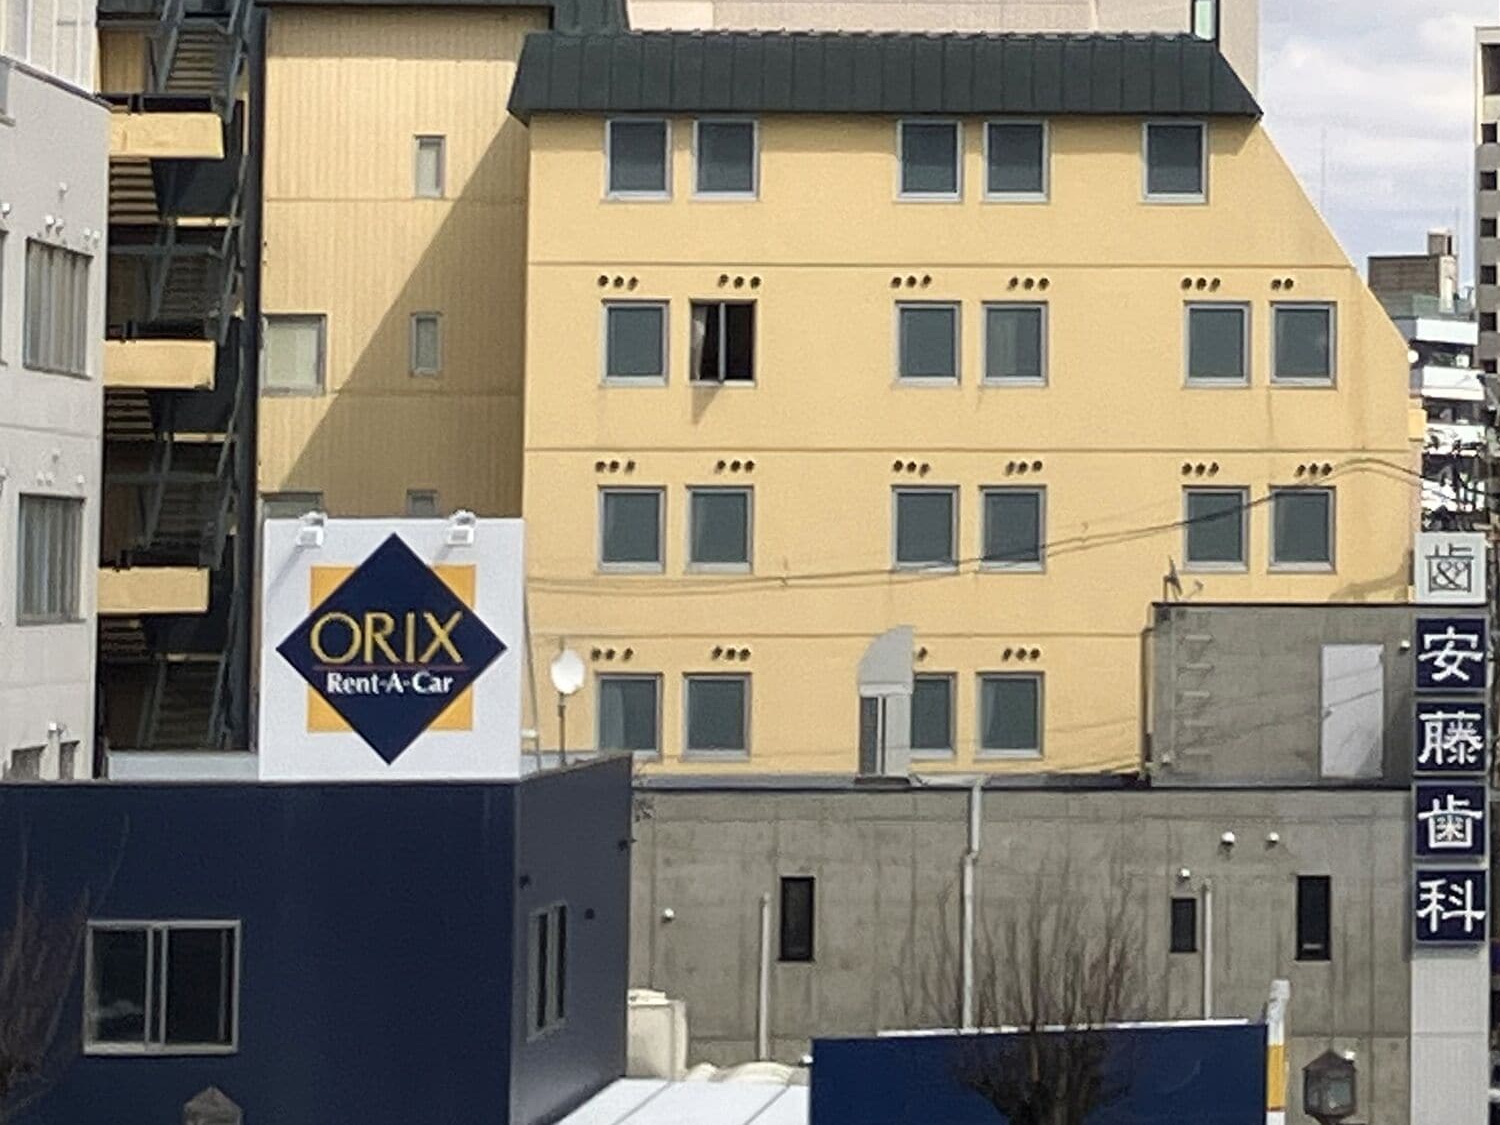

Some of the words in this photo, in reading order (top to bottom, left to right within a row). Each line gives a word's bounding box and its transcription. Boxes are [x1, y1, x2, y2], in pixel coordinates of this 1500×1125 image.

[309, 611, 464, 664] ORIX
[326, 672, 454, 695] Rent-A-Car
[1416, 626, 1486, 934] 安藤歯科
